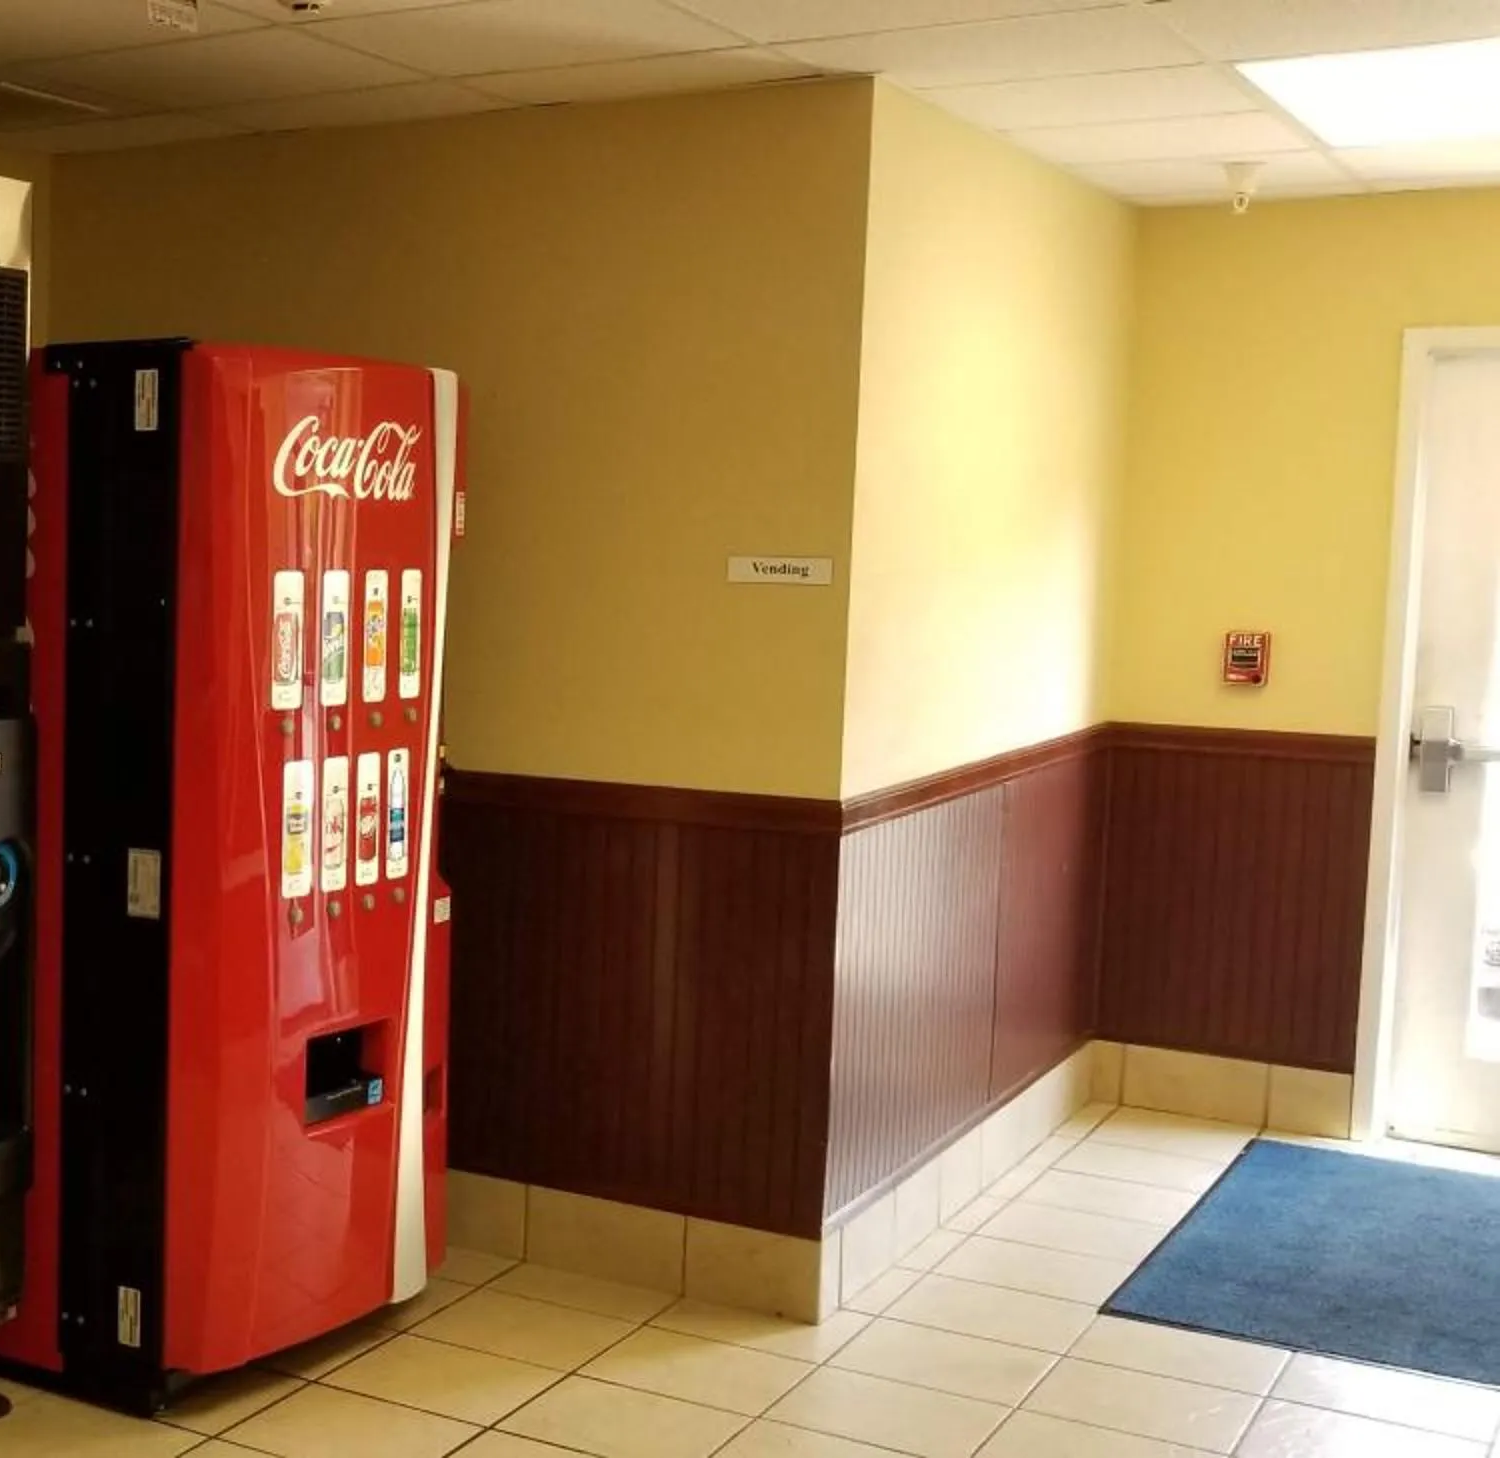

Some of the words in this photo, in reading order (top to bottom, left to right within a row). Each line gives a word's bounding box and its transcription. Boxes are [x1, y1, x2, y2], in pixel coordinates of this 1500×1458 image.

[273, 415, 421, 501] Coca-Cola
[752, 561, 810, 578] Vending
[1229, 635, 1263, 648] FIRE
